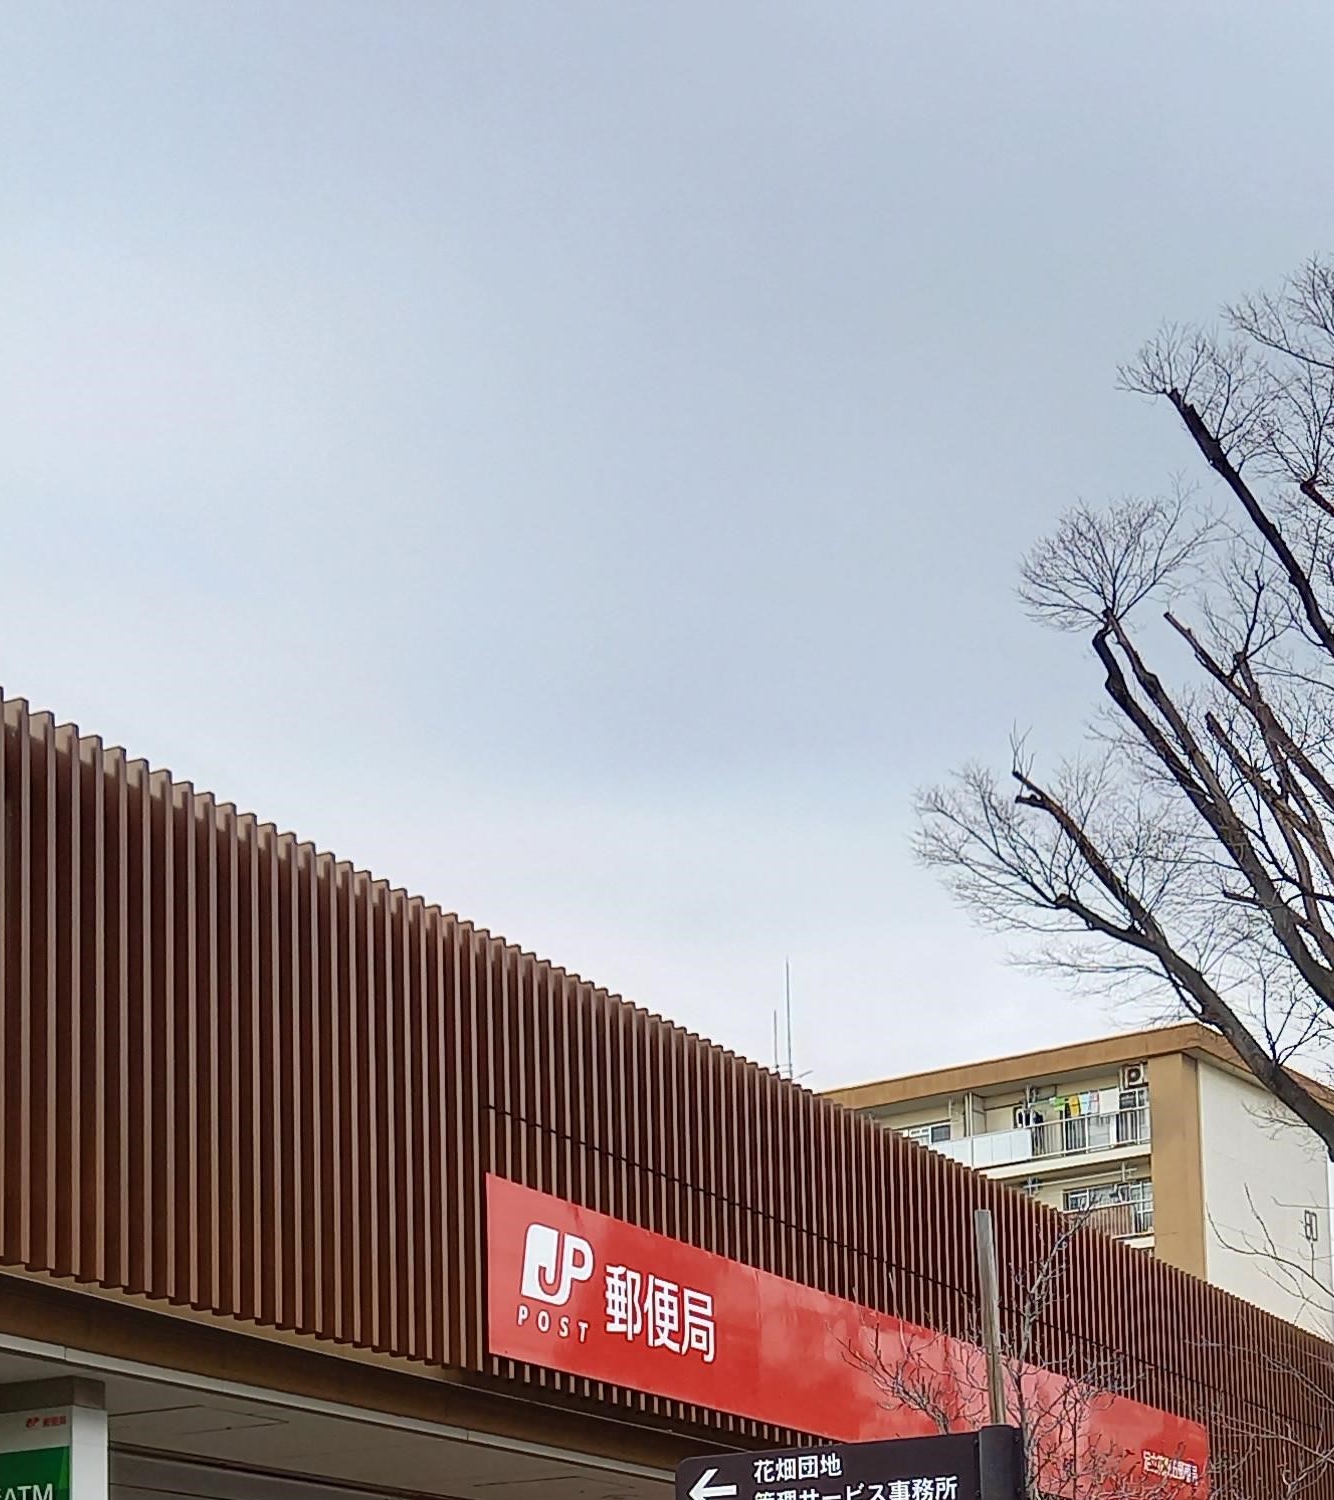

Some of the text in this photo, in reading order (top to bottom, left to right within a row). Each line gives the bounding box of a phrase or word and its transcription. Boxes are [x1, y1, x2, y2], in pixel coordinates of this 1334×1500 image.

[517, 1304, 589, 1343] POST
[605, 1264, 716, 1363] 郵便局
[753, 1453, 843, 1484] 花畑団地
